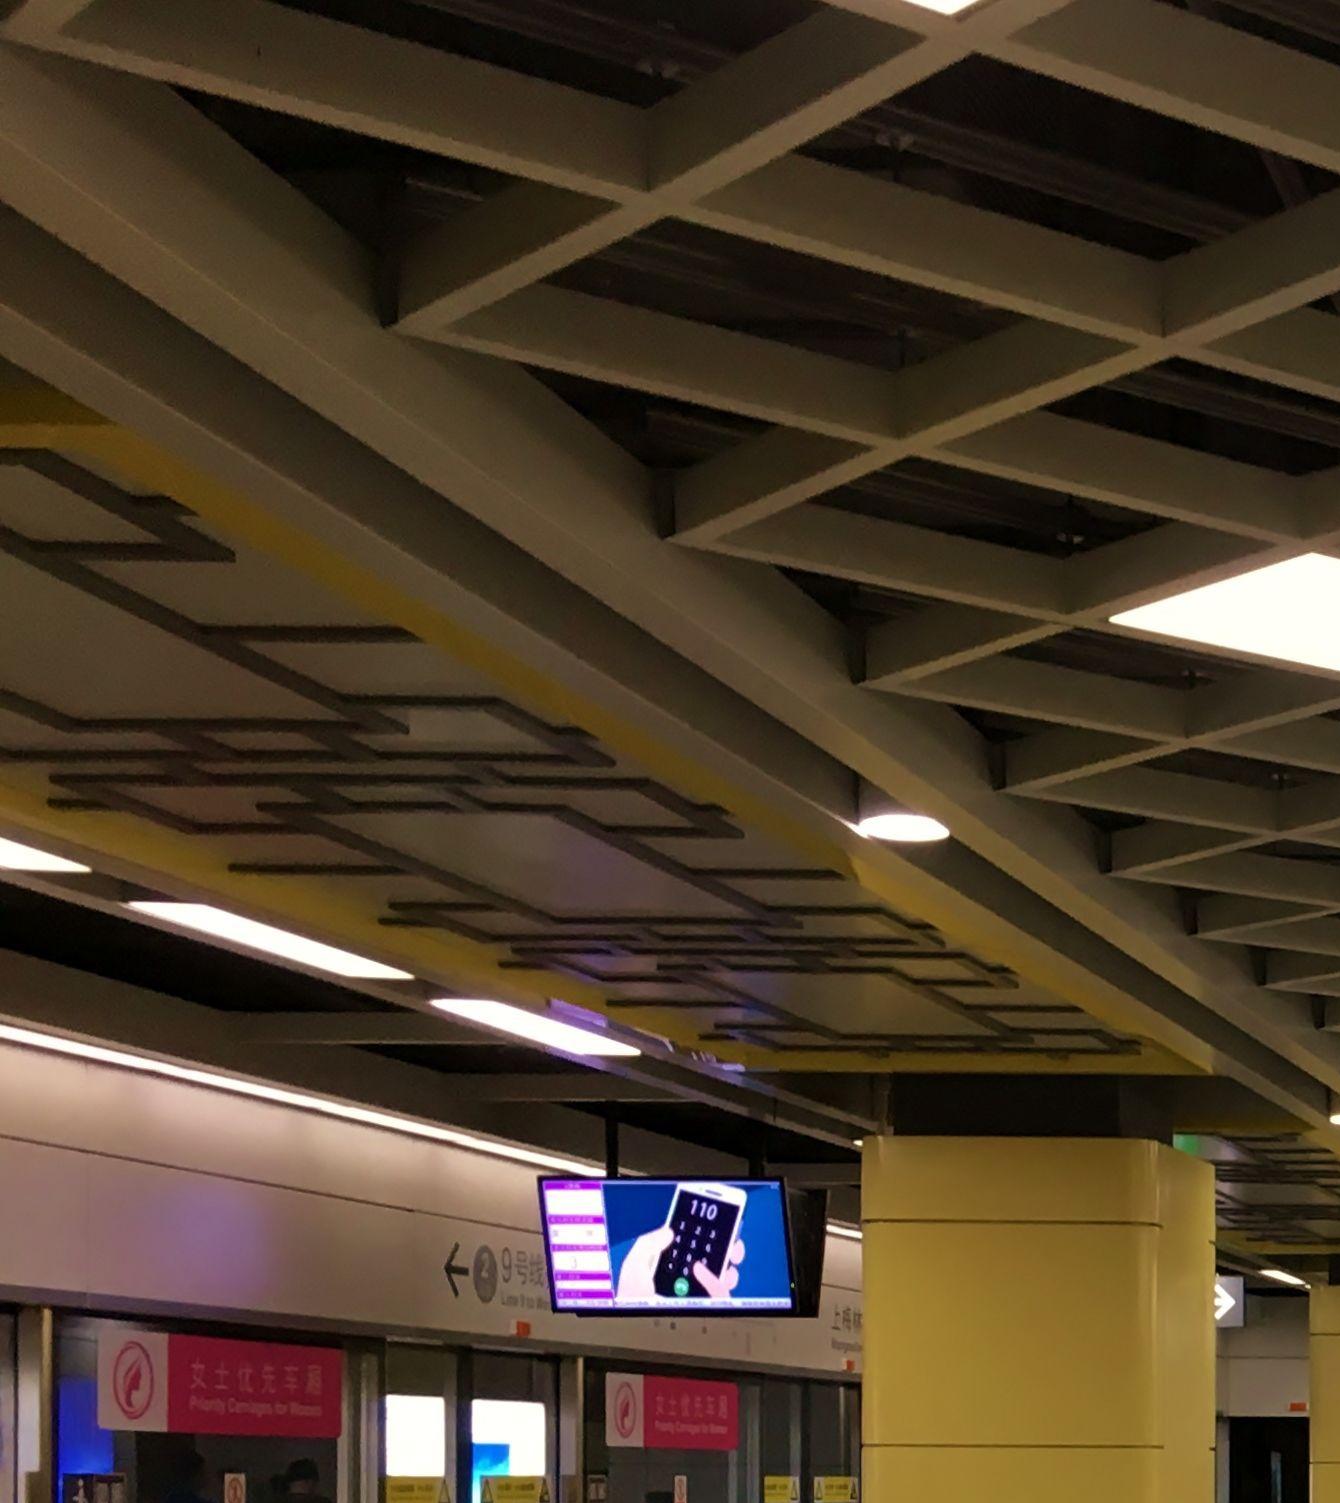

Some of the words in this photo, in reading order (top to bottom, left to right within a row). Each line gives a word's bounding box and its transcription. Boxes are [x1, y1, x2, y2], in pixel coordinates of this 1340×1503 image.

[690, 1199, 718, 1221] 110
[190, 1356, 322, 1396] 女士优先车厢
